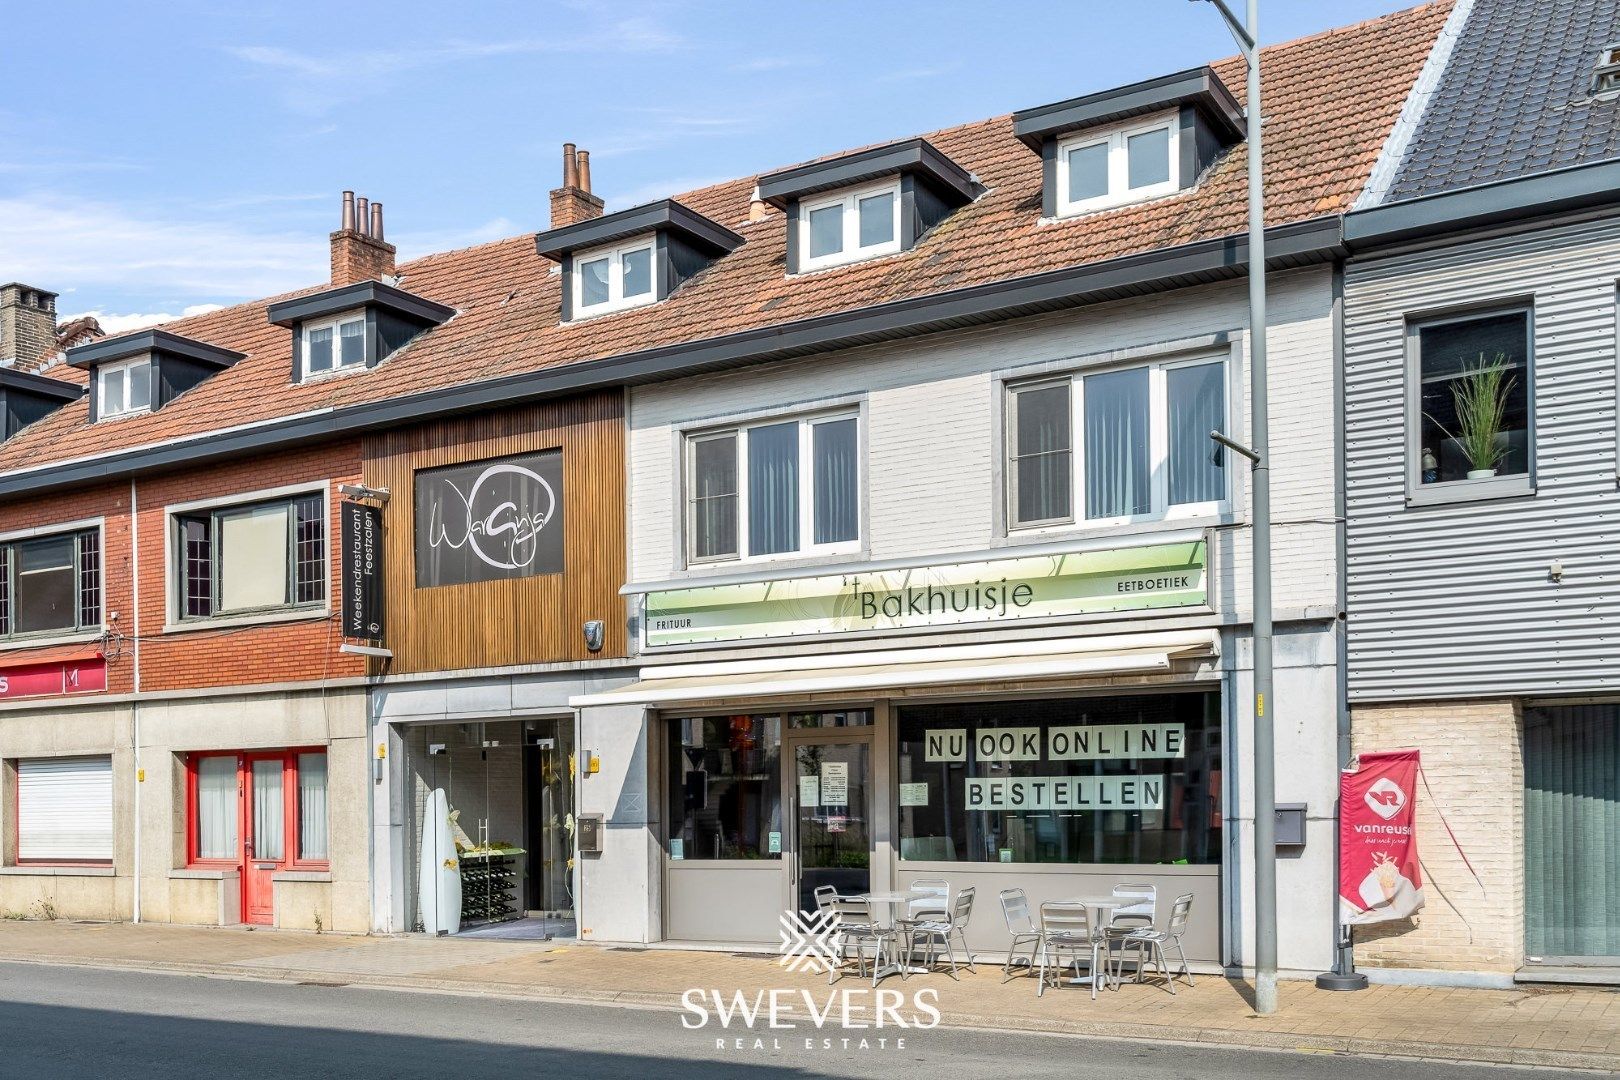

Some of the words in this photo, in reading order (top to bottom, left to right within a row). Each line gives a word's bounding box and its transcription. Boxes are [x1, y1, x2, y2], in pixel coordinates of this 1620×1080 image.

[364, 511, 373, 575] Feestzalen
[353, 508, 362, 630] Weekendrestaurant
[1117, 576, 1189, 592] EETBOETIEK
[861, 577, 1034, 620] Bakhuisje
[656, 618, 692, 630] FRITUUR
[929, 735, 963, 757] NU
[979, 732, 1038, 756] OOK
[1052, 729, 1181, 754] ONLINE
[969, 781, 1160, 806] BESTELLEN
